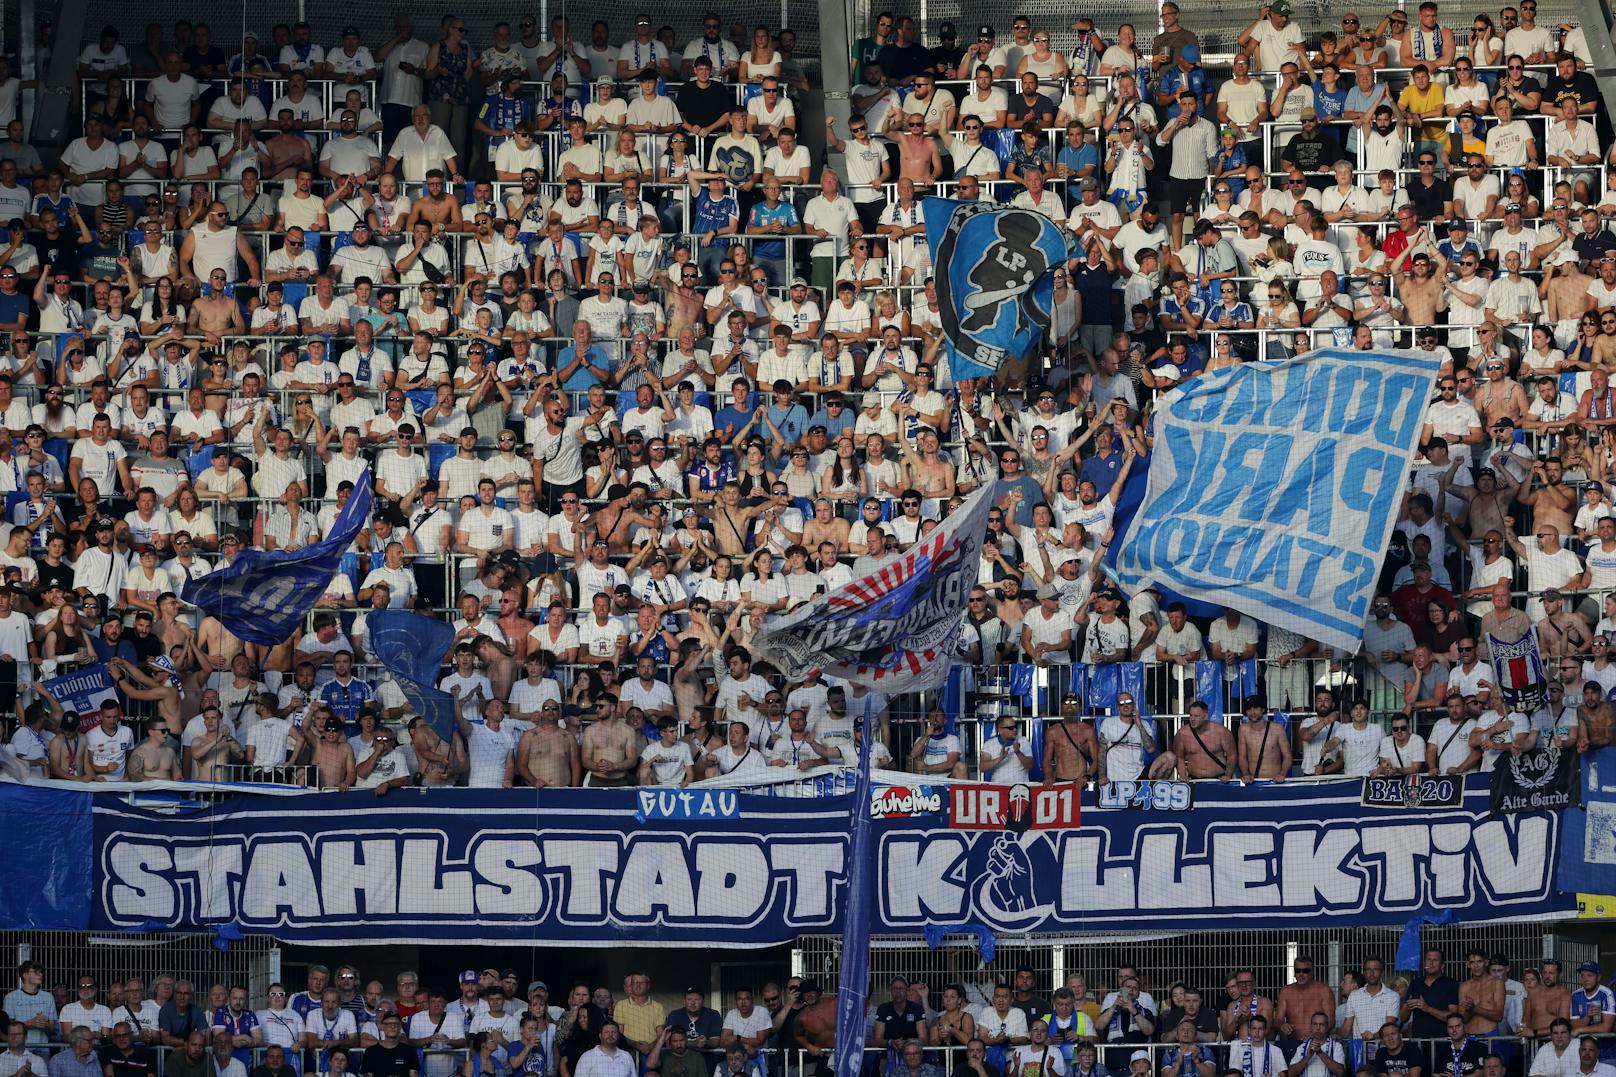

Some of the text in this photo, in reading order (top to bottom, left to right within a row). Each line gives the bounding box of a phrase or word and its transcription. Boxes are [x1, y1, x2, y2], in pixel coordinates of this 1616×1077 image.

[995, 245, 1028, 272] LP
[1519, 748, 1548, 772] AG
[638, 791, 736, 817] GUTAU
[870, 788, 942, 816] auhelme
[1099, 780, 1191, 811] LP 99
[1369, 779, 1454, 802] BA 20
[1500, 790, 1569, 810] Alte Garde
[955, 788, 1073, 825] UR 01
[106, 835, 847, 919] STAHLSTADT
